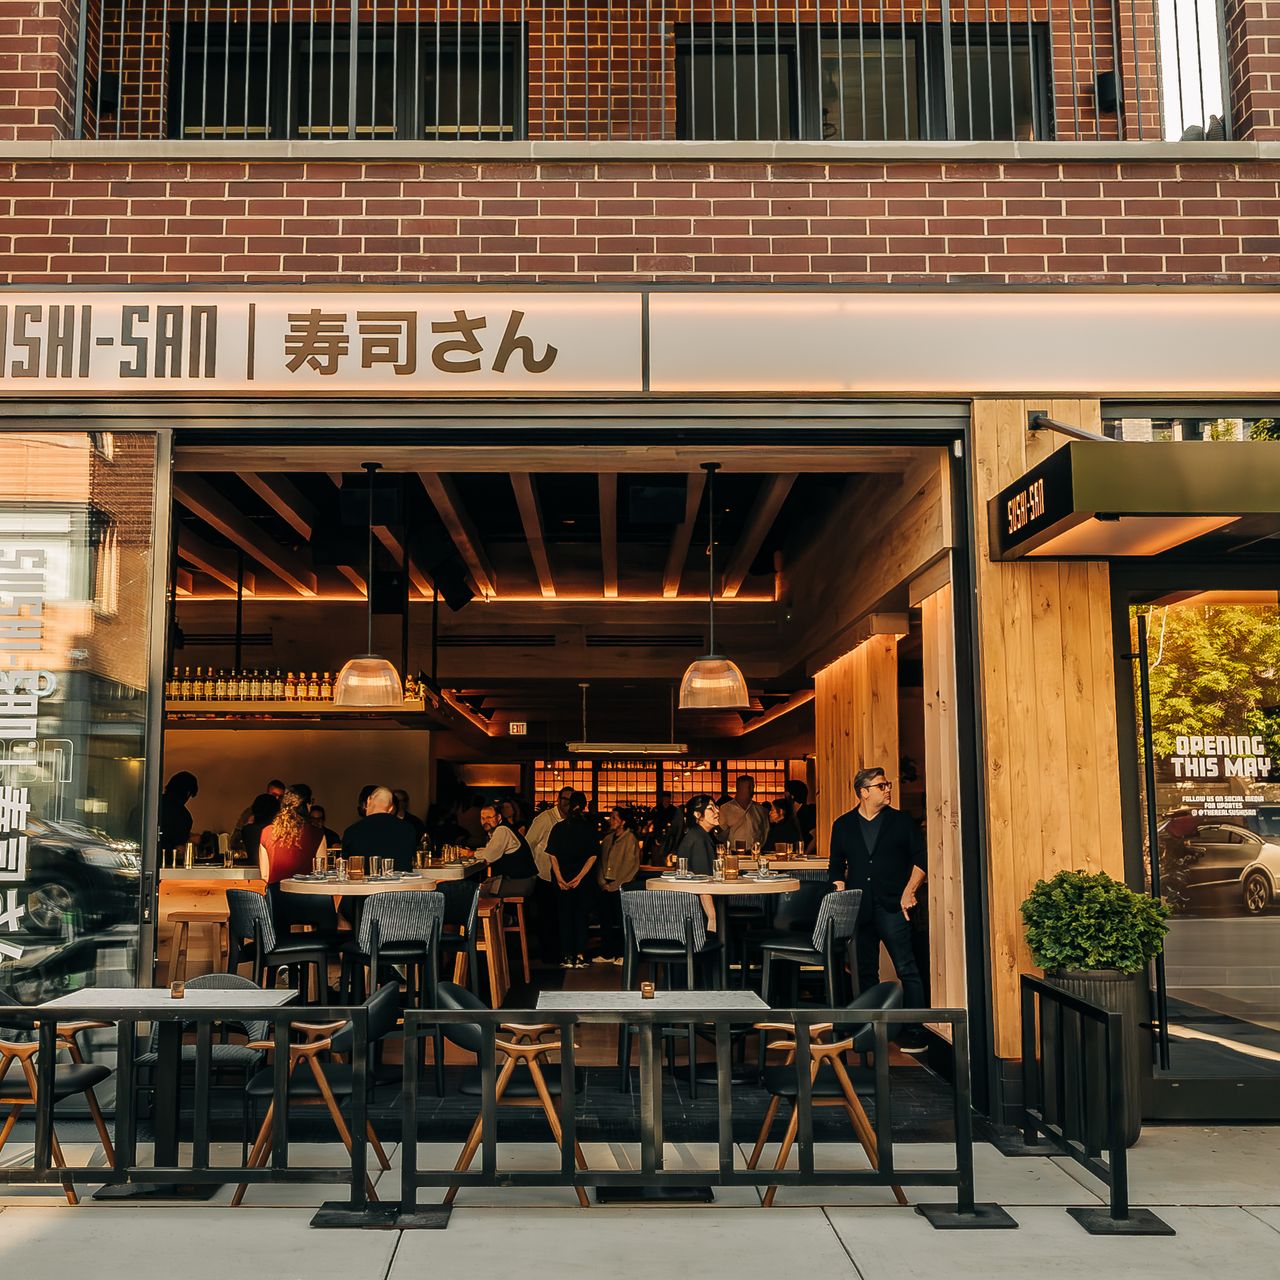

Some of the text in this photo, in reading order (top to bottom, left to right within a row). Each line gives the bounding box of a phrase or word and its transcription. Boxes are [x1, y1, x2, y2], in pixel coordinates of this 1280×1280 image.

[285, 308, 558, 375] 寿司さん
[1007, 478, 1045, 535] SUSHI-SAN
[1175, 735, 1265, 756] OPENING
[1170, 757, 1272, 778] THIS MAY
